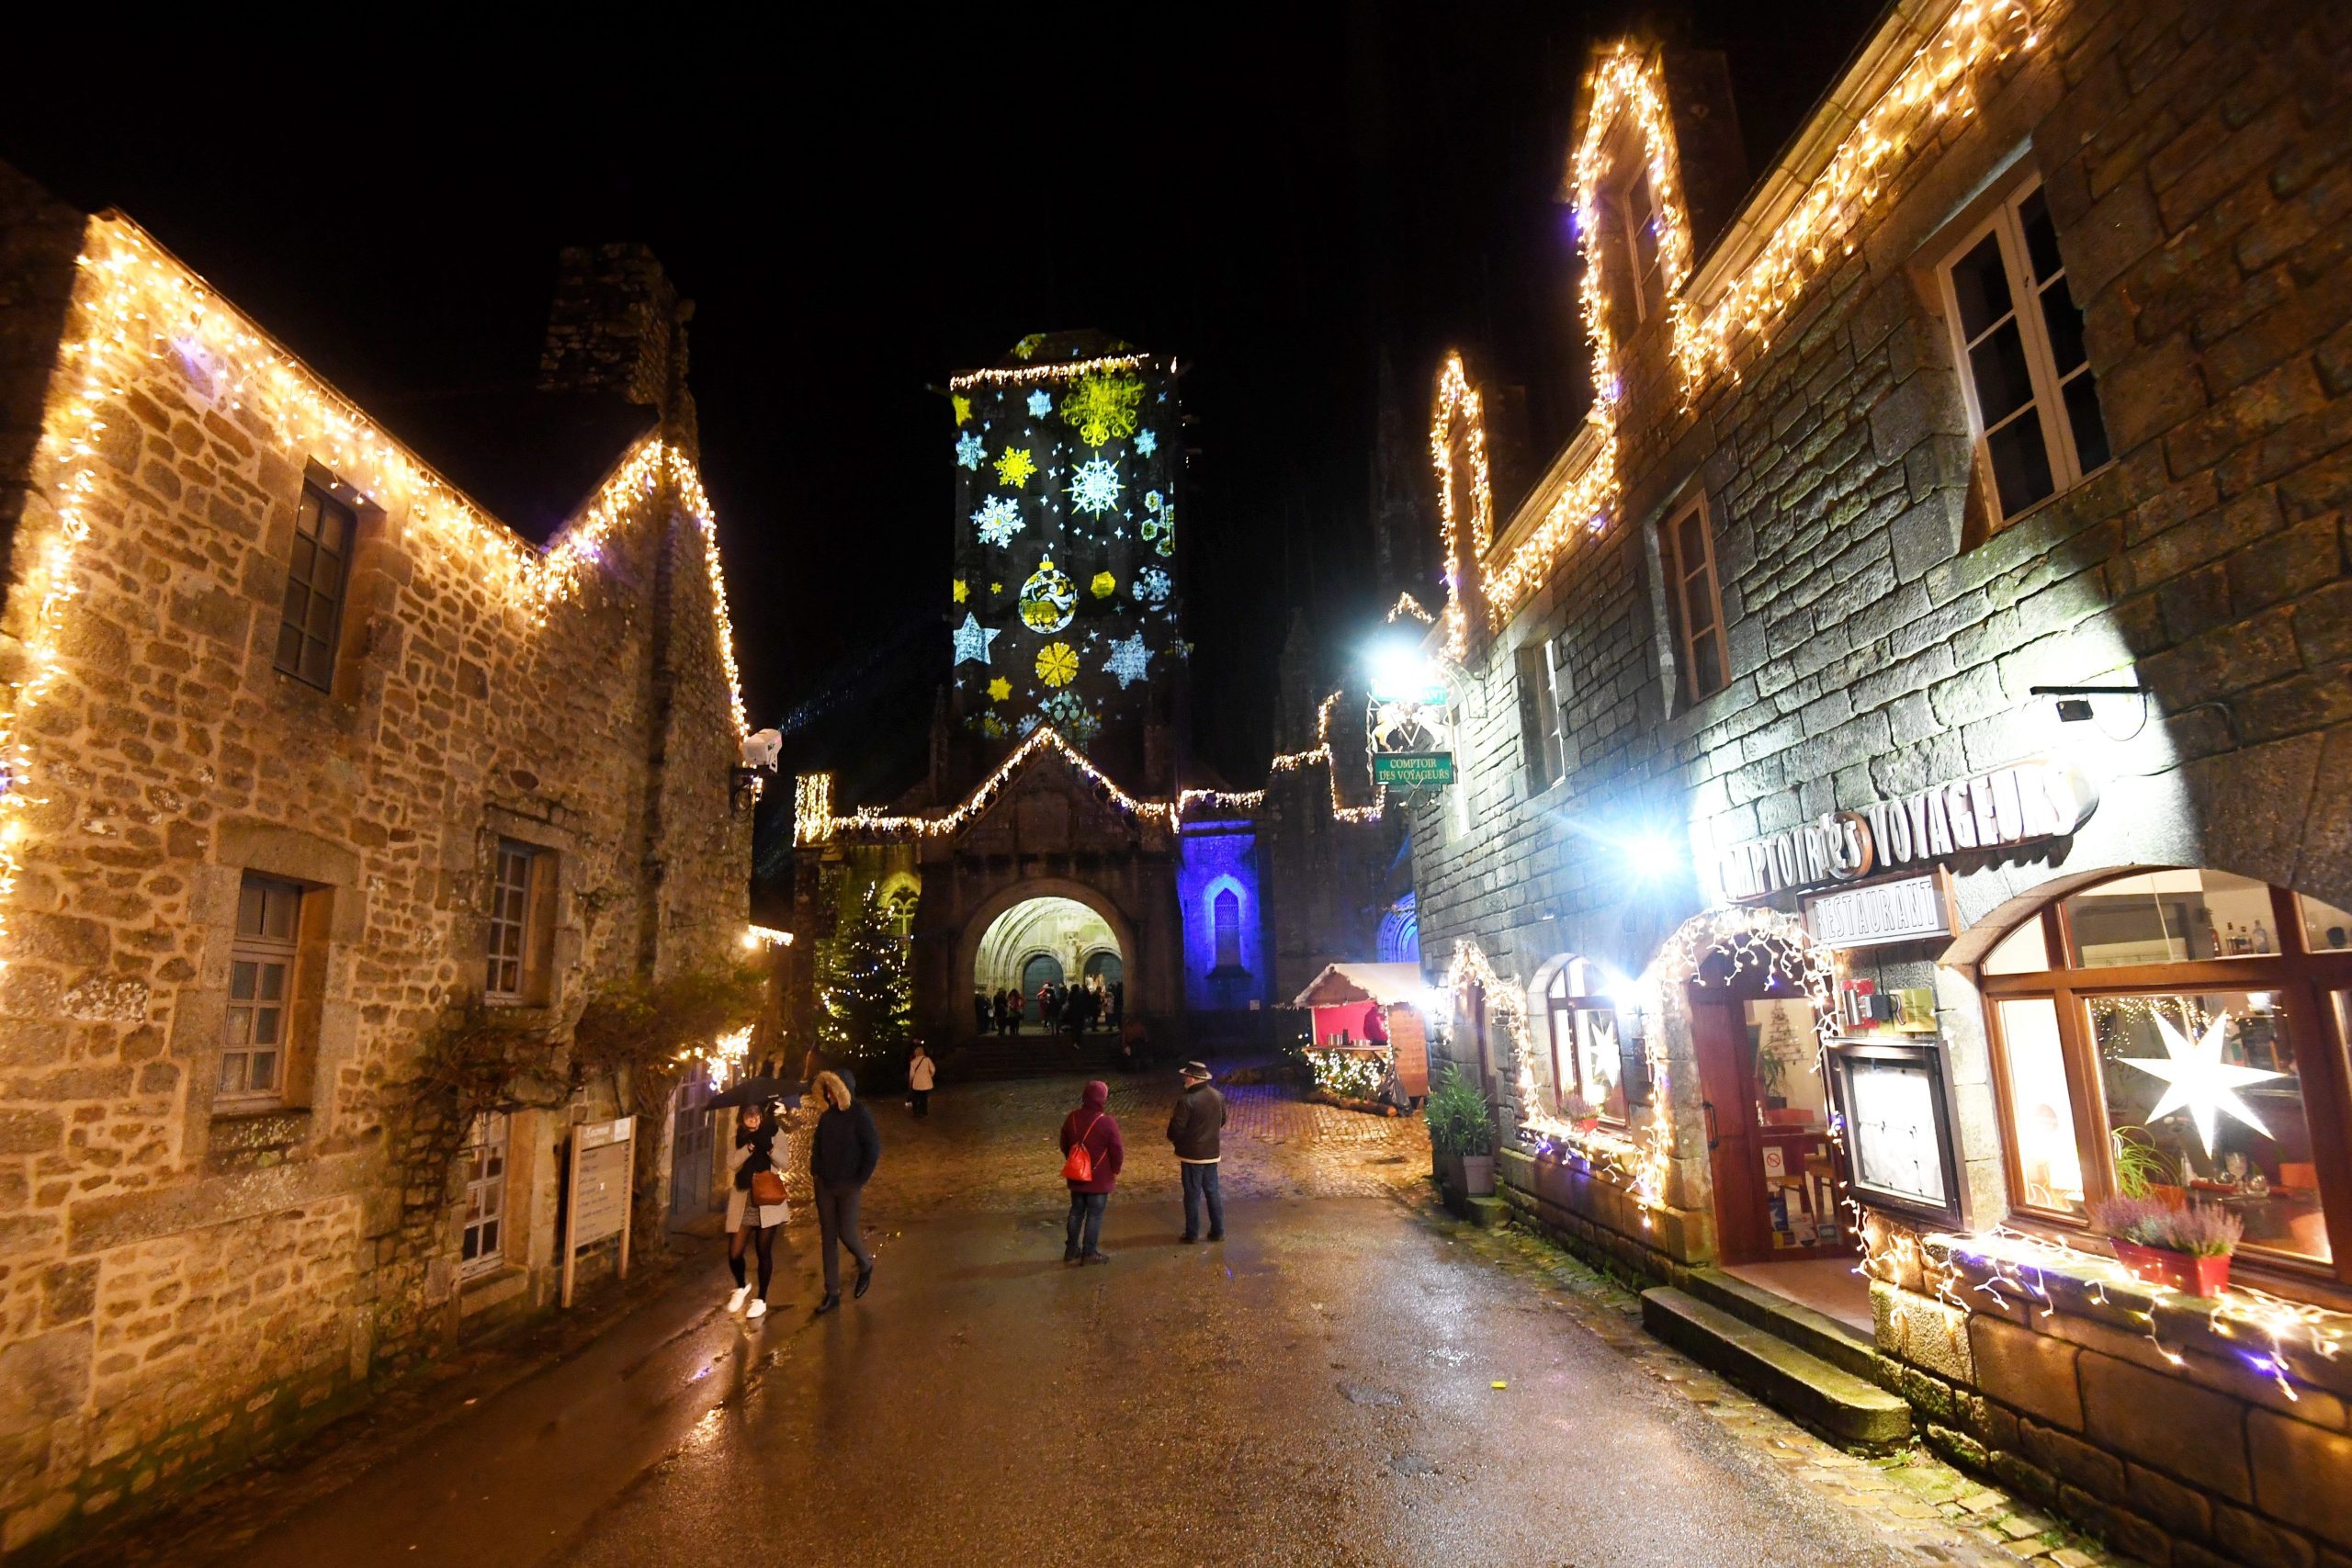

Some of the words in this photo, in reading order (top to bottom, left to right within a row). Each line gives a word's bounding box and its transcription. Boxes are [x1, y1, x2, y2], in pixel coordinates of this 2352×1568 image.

[1389, 758, 1437, 769] COMPTOIR
[1379, 770, 1396, 780] DES
[1396, 768, 1450, 780] VOYAGEURS
[1813, 880, 1935, 941] RESTAURANT
